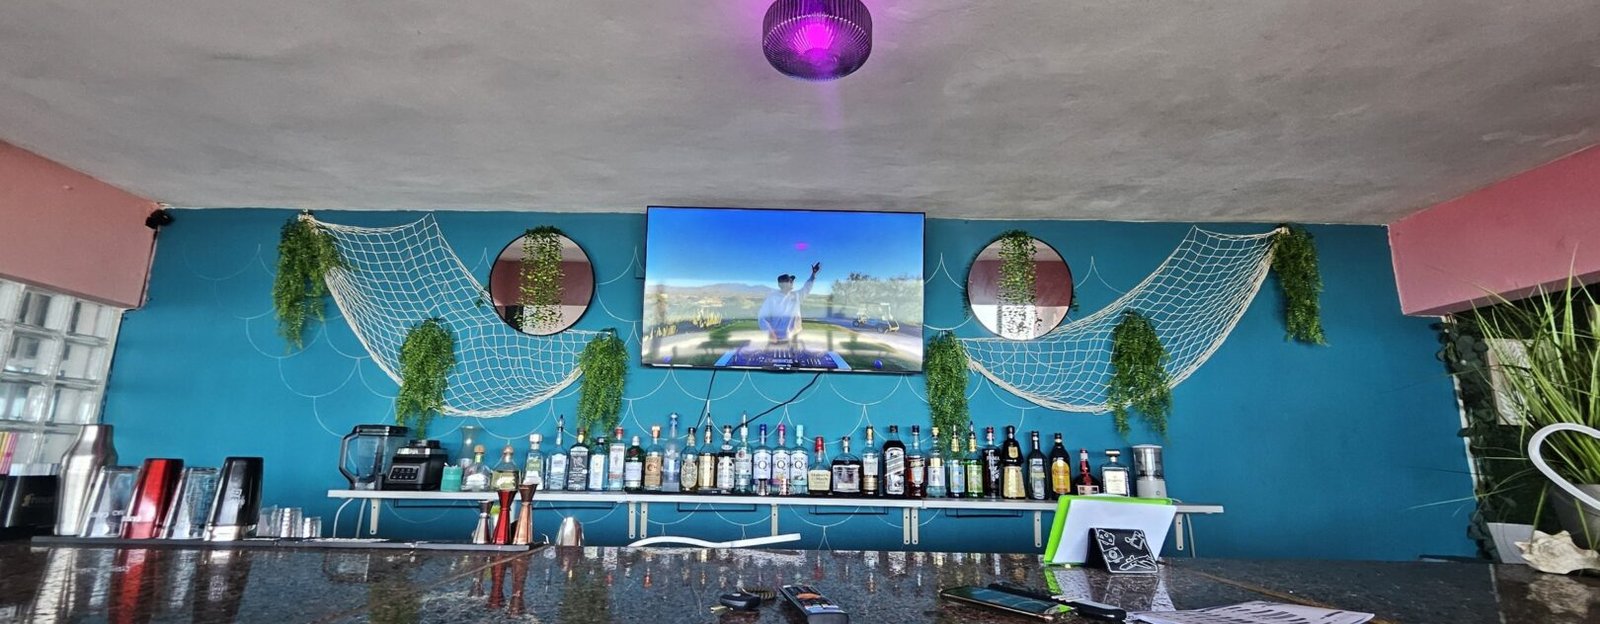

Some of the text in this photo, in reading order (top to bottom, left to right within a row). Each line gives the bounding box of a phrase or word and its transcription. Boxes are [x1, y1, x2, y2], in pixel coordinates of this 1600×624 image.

[758, 460, 767, 471] Q
[777, 460, 785, 470] Q
[794, 460, 803, 470] Q
